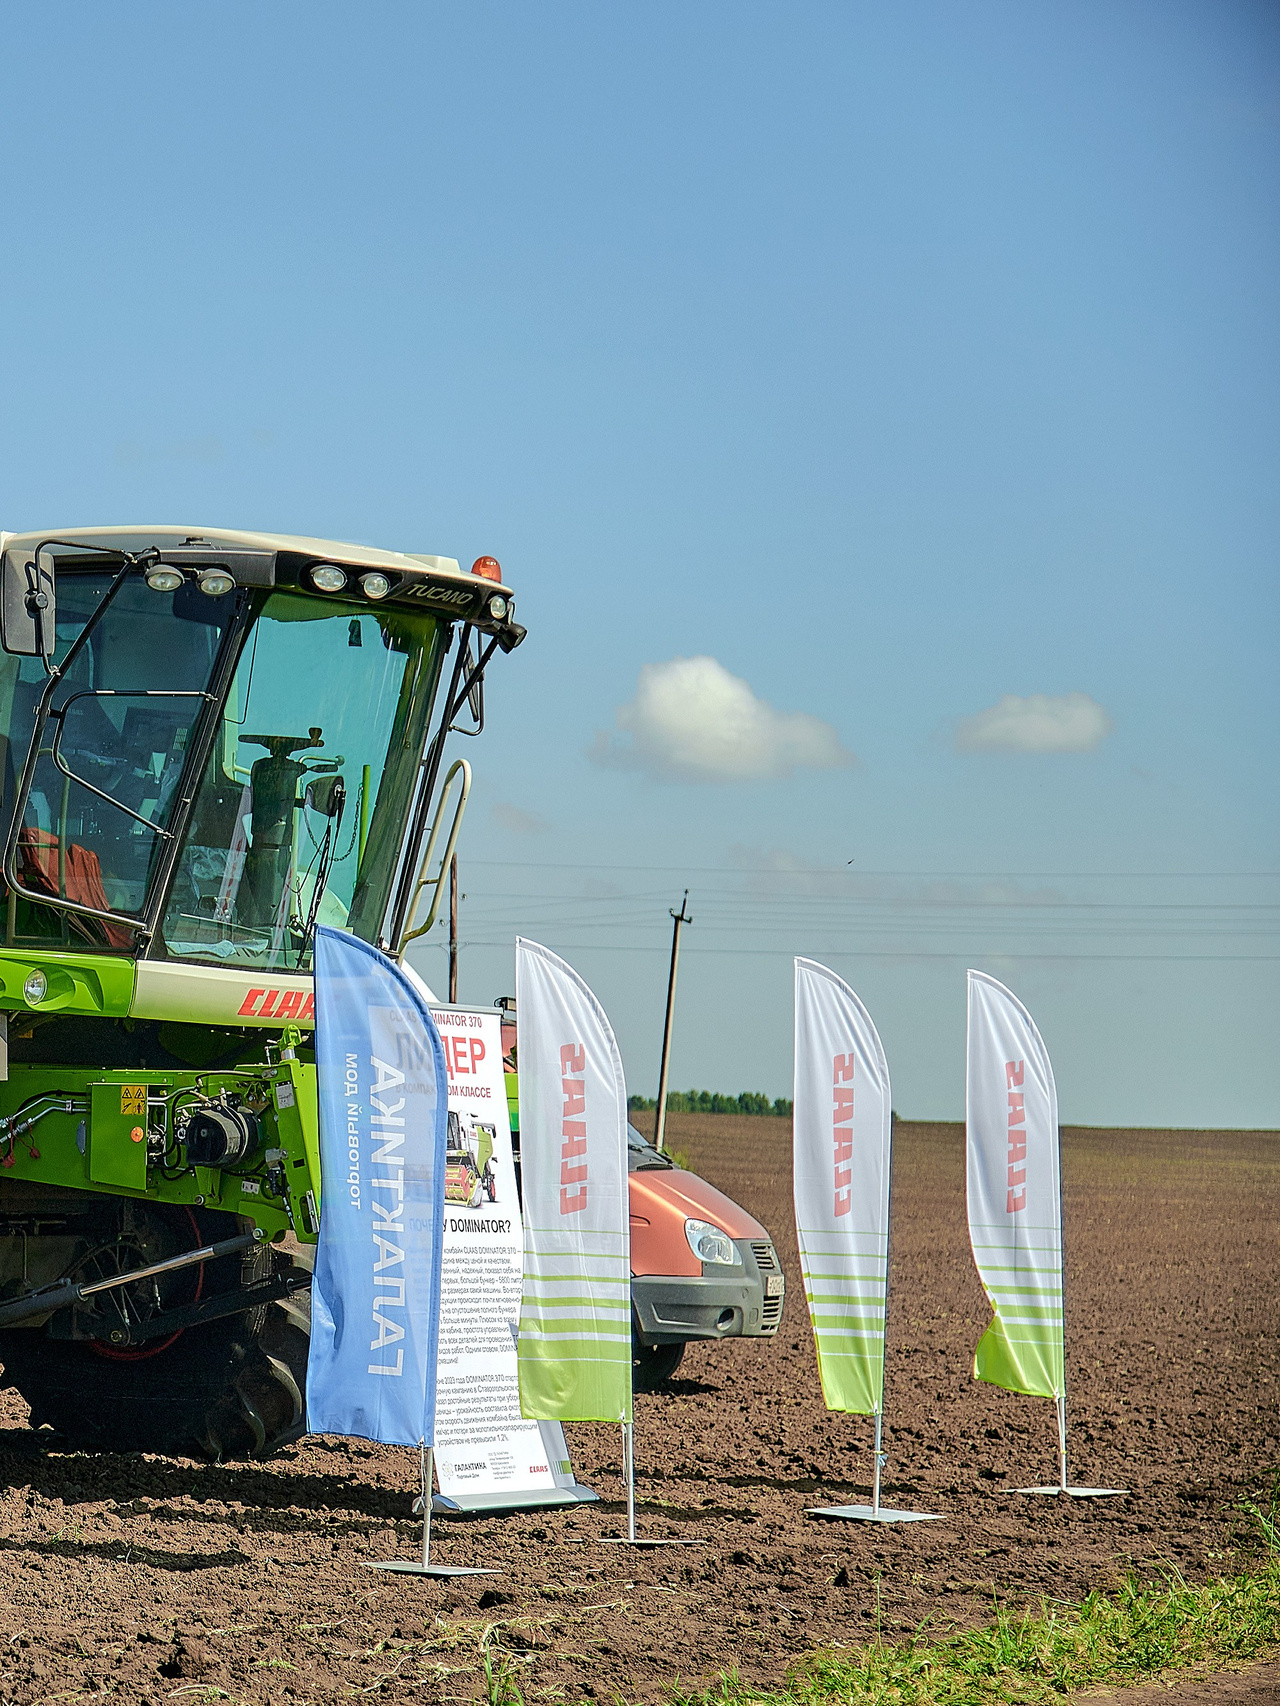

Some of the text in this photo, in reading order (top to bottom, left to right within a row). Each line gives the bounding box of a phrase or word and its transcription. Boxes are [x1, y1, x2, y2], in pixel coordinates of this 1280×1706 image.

[407, 583, 474, 605] TUCANO
[237, 988, 315, 1020] CLAA
[432, 1013, 468, 1027] MINATOR
[468, 1016, 483, 1028] 370
[459, 1085, 492, 1098] КЛАССЕ
[450, 1218, 511, 1234] DOMINATOR?
[454, 1462, 487, 1472] ГАЛАКТИКА
[529, 1465, 548, 1473] CLAAS
